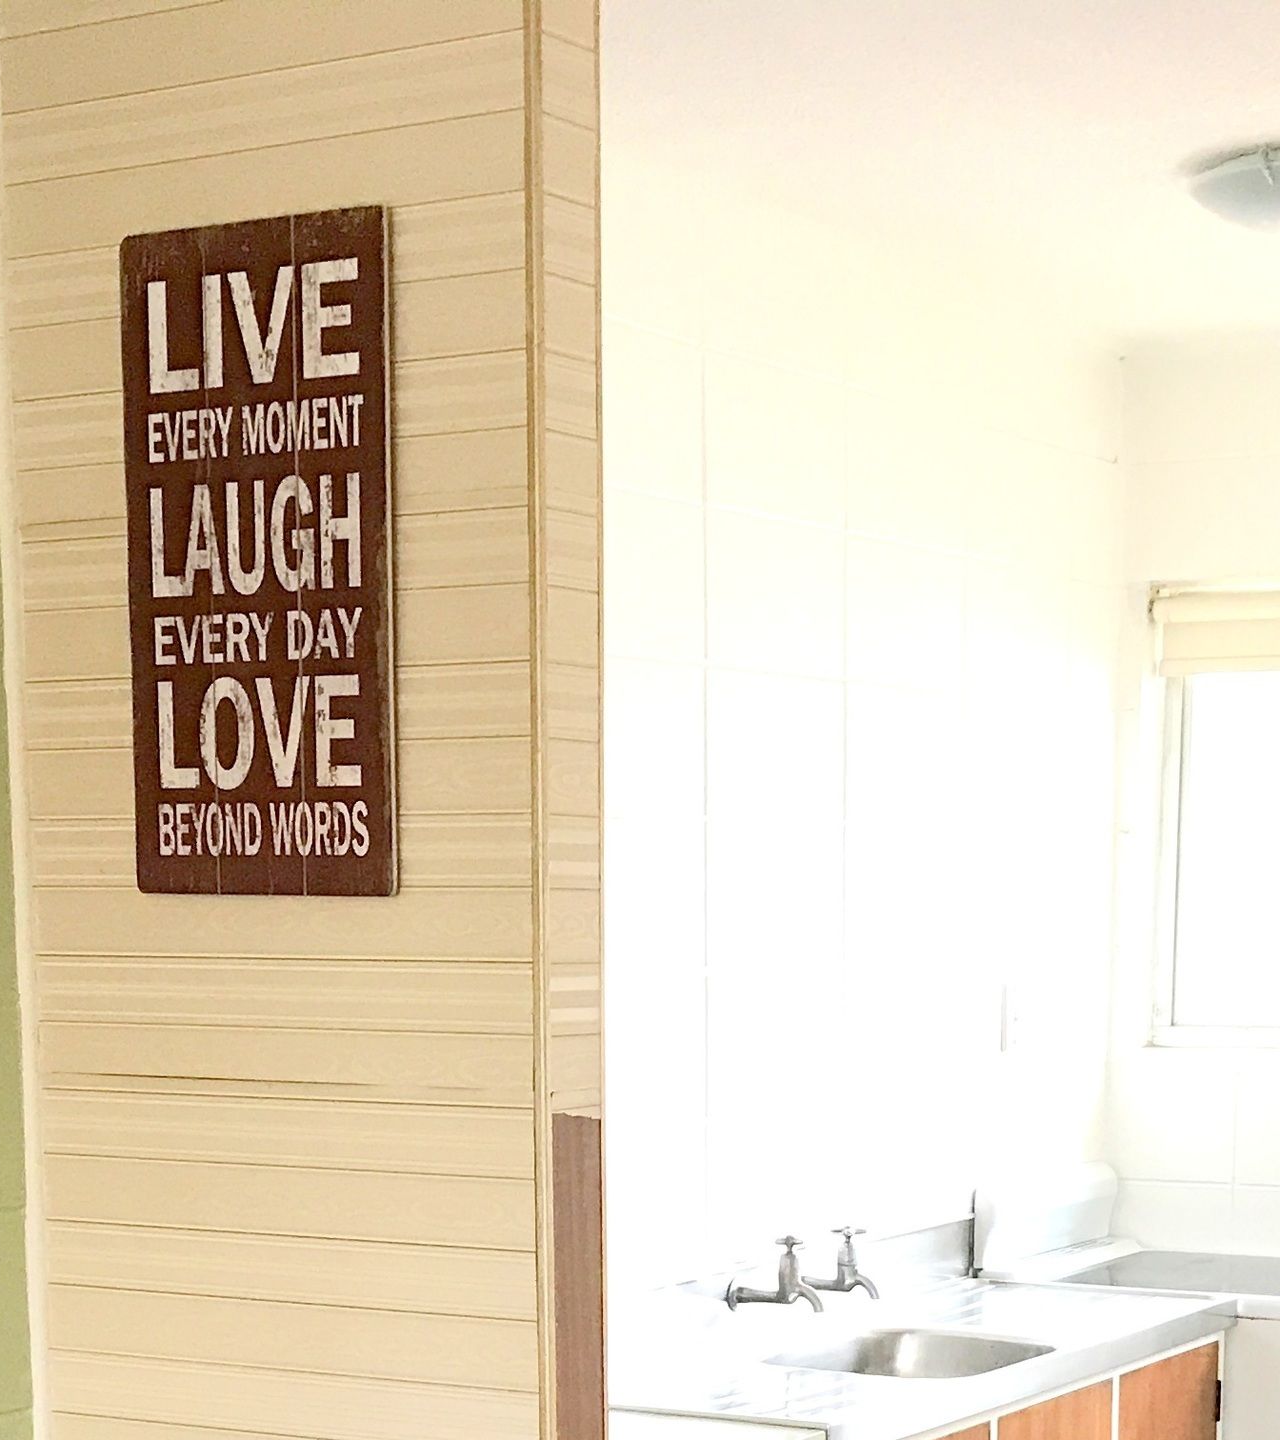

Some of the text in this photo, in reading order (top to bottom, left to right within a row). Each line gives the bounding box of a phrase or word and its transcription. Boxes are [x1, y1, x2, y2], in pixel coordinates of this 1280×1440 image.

[147, 257, 360, 394] LIVE
[148, 394, 364, 463] EVERY MOMENT
[149, 472, 363, 598] LAUGH
[154, 607, 363, 665] EVERY DAY
[157, 674, 362, 790] LOVE
[158, 800, 370, 857] BEYOND WORDS
